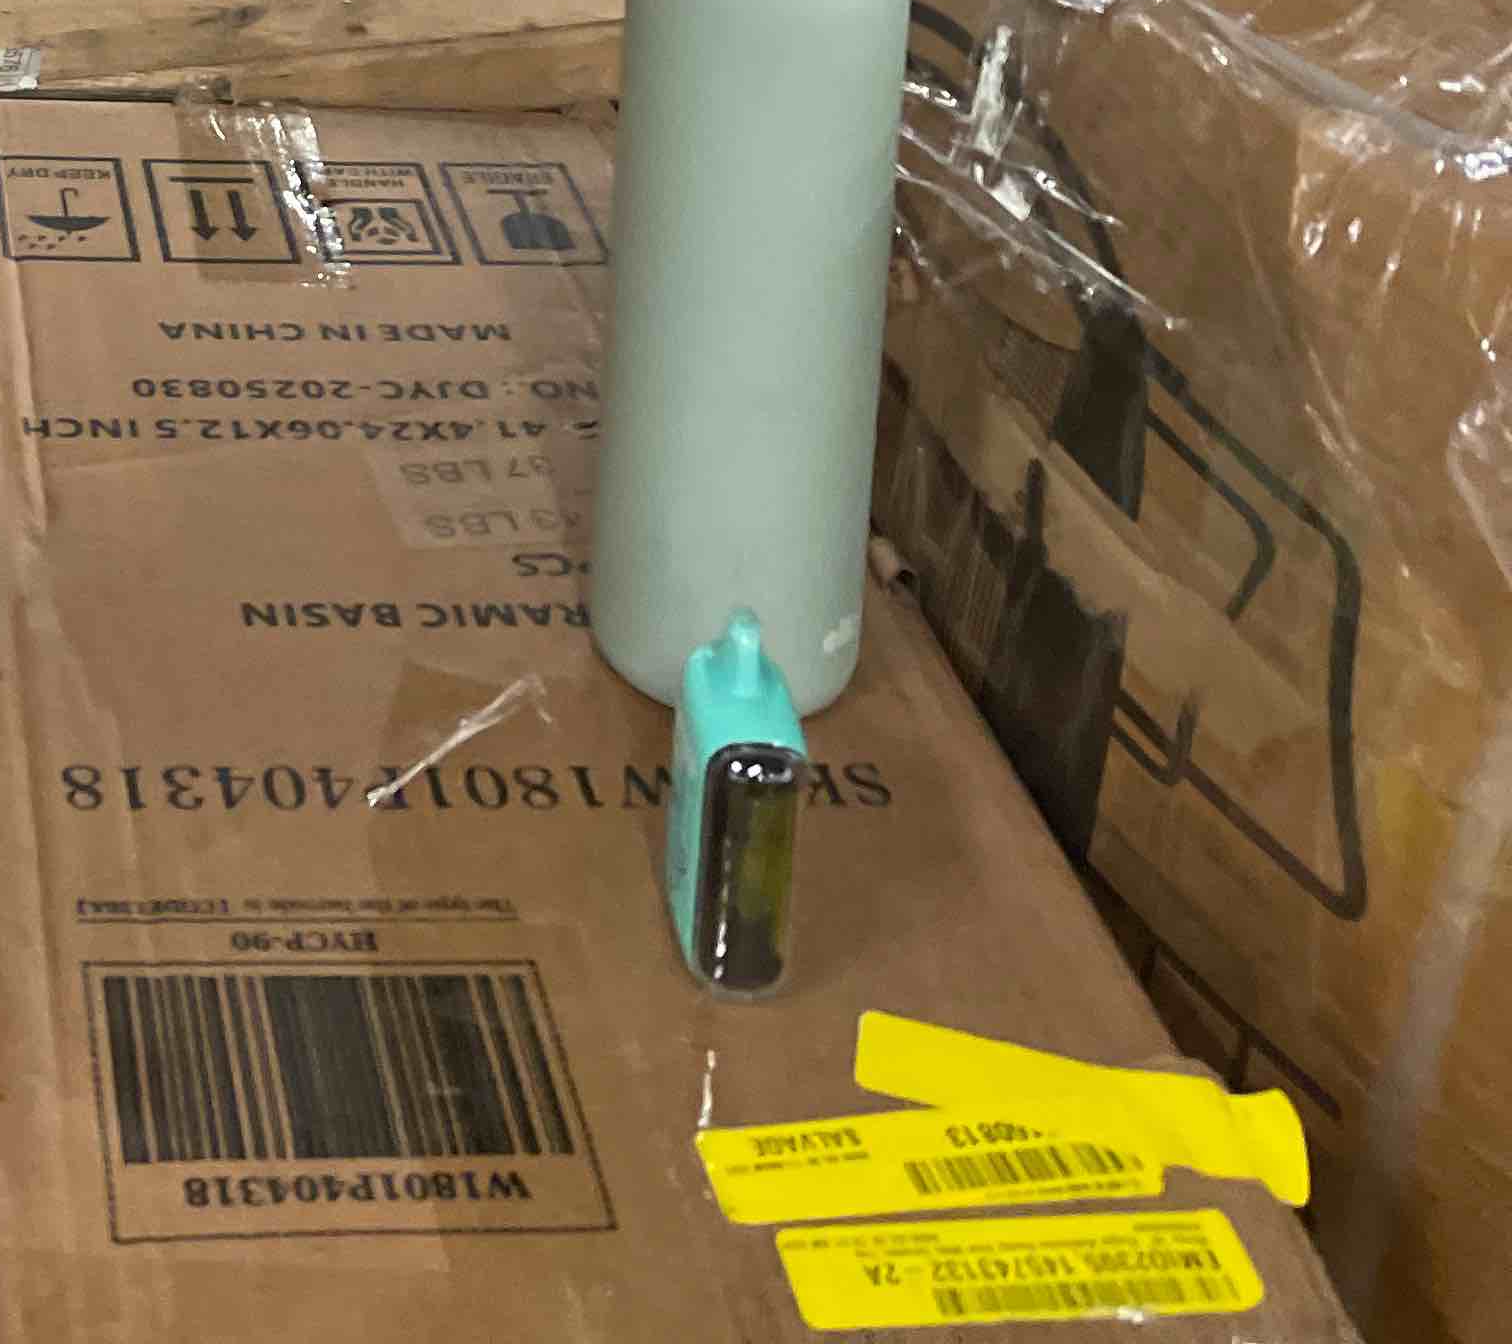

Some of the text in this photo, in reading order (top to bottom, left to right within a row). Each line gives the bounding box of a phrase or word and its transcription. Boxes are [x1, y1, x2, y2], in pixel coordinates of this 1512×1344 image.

[6, 166, 111, 181] KEEP DRY
[157, 321, 512, 342] MADE IN CHINA
[22, 416, 140, 440] INCH
[239, 601, 592, 628] RAMIC BASIN
[183, 1169, 532, 1209] W1801P404318
